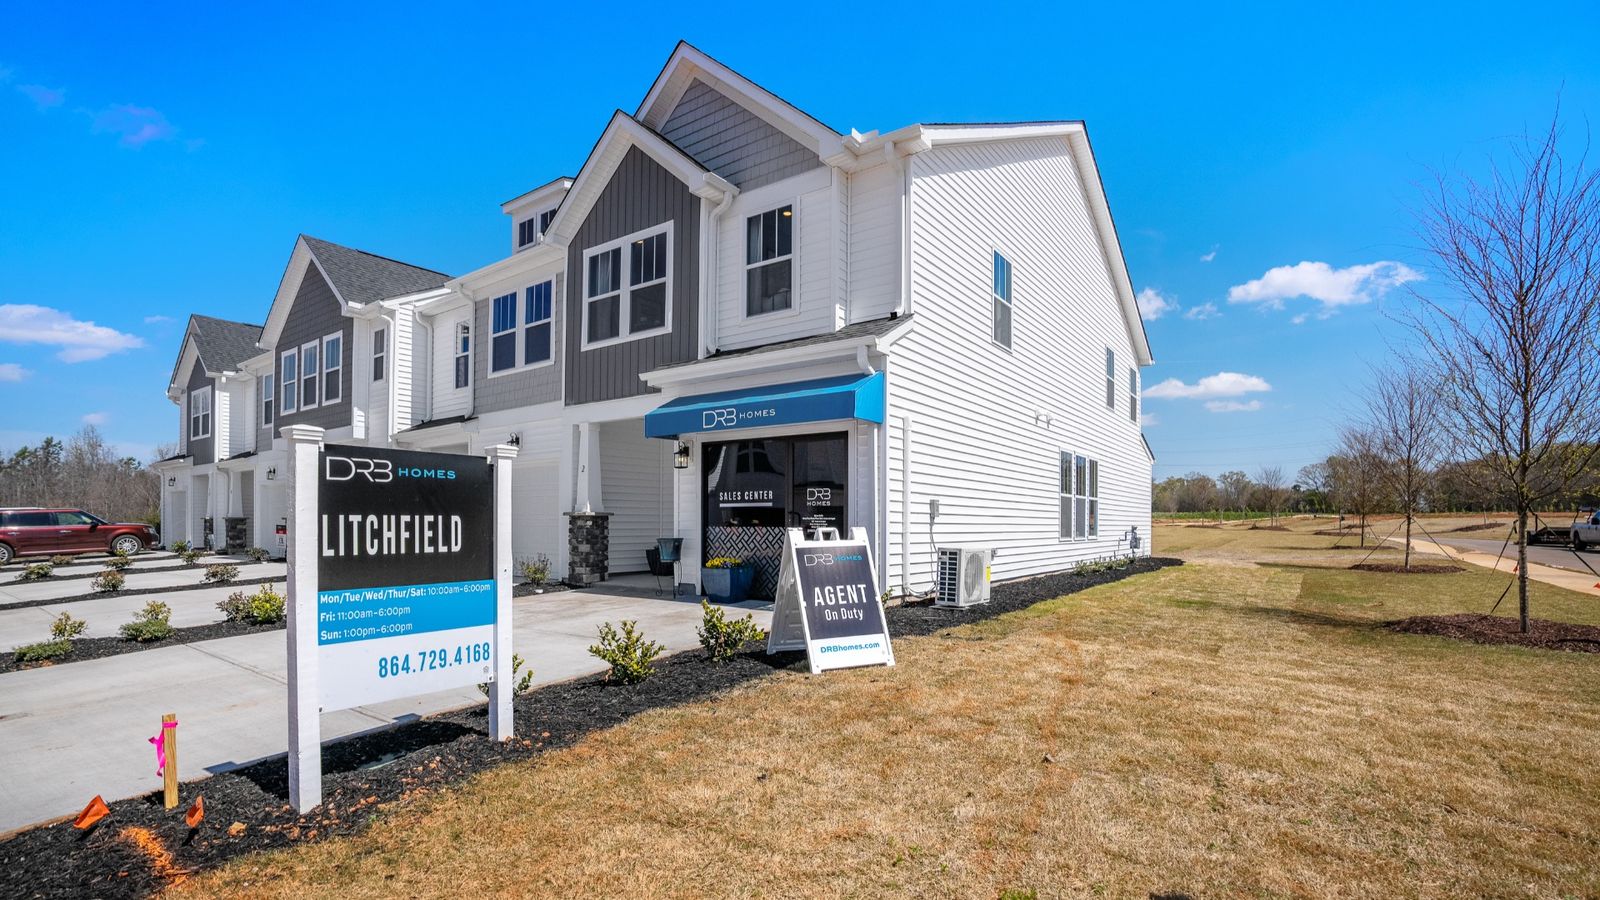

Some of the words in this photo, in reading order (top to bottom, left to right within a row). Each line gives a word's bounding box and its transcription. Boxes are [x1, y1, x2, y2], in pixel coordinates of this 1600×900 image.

[702, 408, 737, 429] DRB
[739, 408, 776, 419] HOMES
[326, 456, 393, 483] DRB
[398, 467, 456, 480] HOMES
[719, 491, 741, 501] SALES
[744, 490, 773, 500] CENTER
[806, 488, 831, 500] DRB
[322, 514, 462, 557] LITCHFIELD
[804, 553, 834, 567] DRB
[320, 588, 426, 604] Mon/Tue/Wed/Thur/Sat:
[814, 584, 867, 607] AGENT
[320, 612, 336, 623] Fri:
[824, 609, 839, 621] On
[840, 607, 863, 621] Duty
[320, 630, 342, 641] Sun:
[820, 642, 880, 653] DRBhomes.com
[378, 642, 490, 678] 864.729.4168
